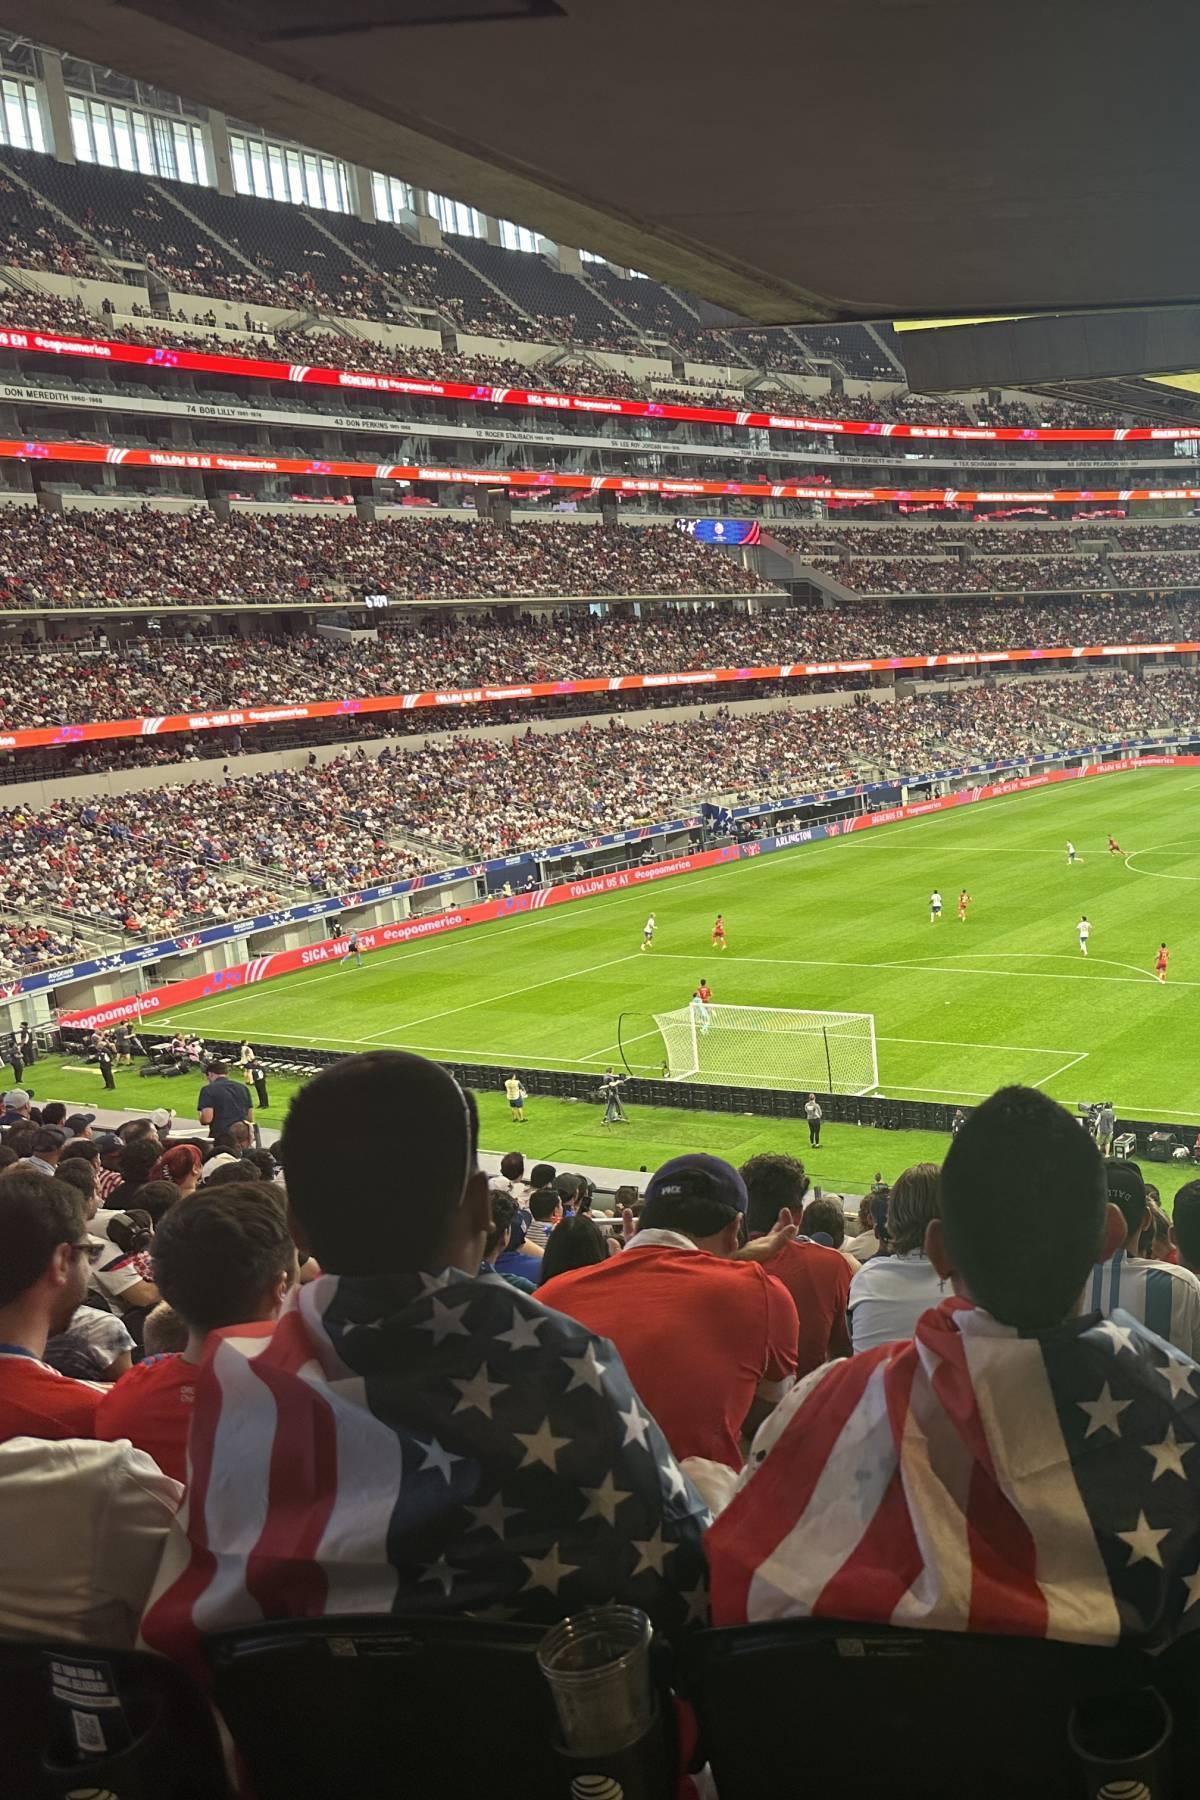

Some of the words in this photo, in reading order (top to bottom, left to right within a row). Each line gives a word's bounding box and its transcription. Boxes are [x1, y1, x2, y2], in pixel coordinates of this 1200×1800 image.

[35, 337, 111, 357] @copaamerica
[4, 387, 23, 398] DON
[26, 388, 69, 401] MEREDITH
[186, 405, 196, 413] 74
[199, 406, 216, 414] BOB
[217, 407, 236, 415] LILLY
[335, 418, 344, 426] 43
[362, 421, 388, 430] PERKINS
[485, 430, 504, 439] ROGER
[506, 433, 533, 441] STAUBACH
[775, 830, 812, 848] ARLINGTON
[571, 879, 604, 897] FOLLOW
[606, 876, 617, 888] US
[619, 874, 630, 886] AT
[634, 860, 691, 880] @copaamerica
[383, 914, 463, 941] @copaamerica
